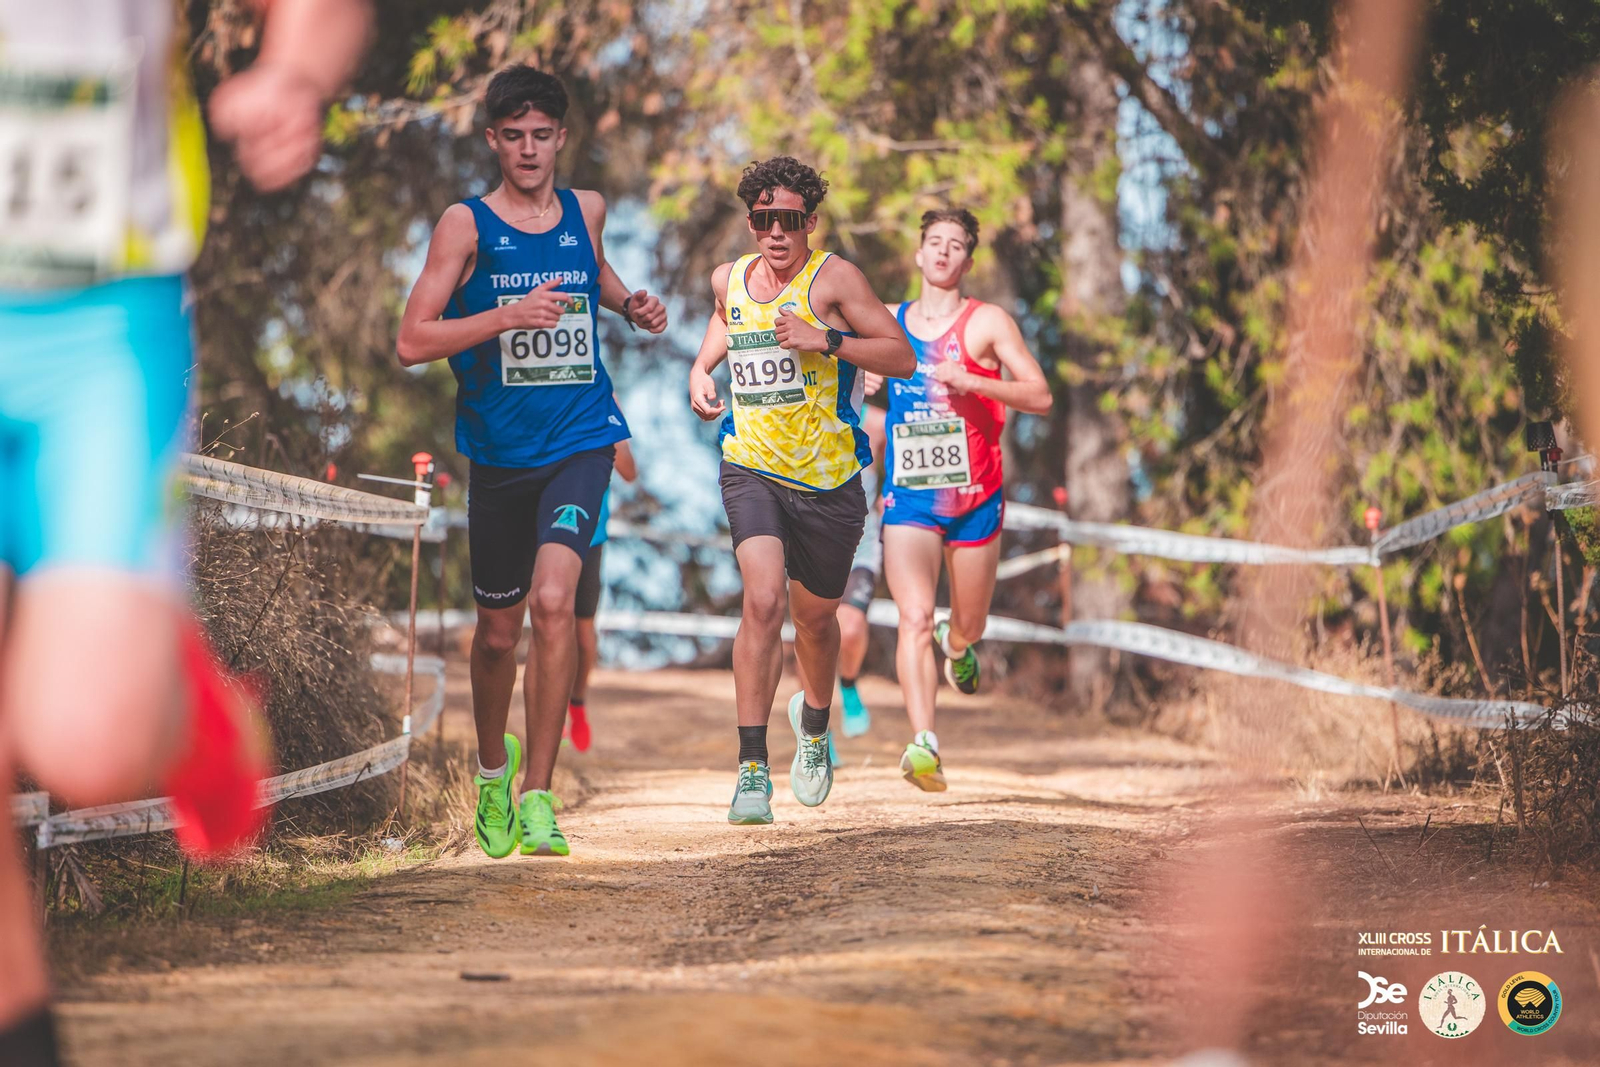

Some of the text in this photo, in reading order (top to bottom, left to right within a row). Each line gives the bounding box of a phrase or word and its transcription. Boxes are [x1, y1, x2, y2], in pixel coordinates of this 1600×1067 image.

[490, 270, 588, 289] TROTASIERRA
[510, 328, 588, 362] 6098
[733, 357, 796, 387] 8199
[902, 445, 961, 471] 8188
